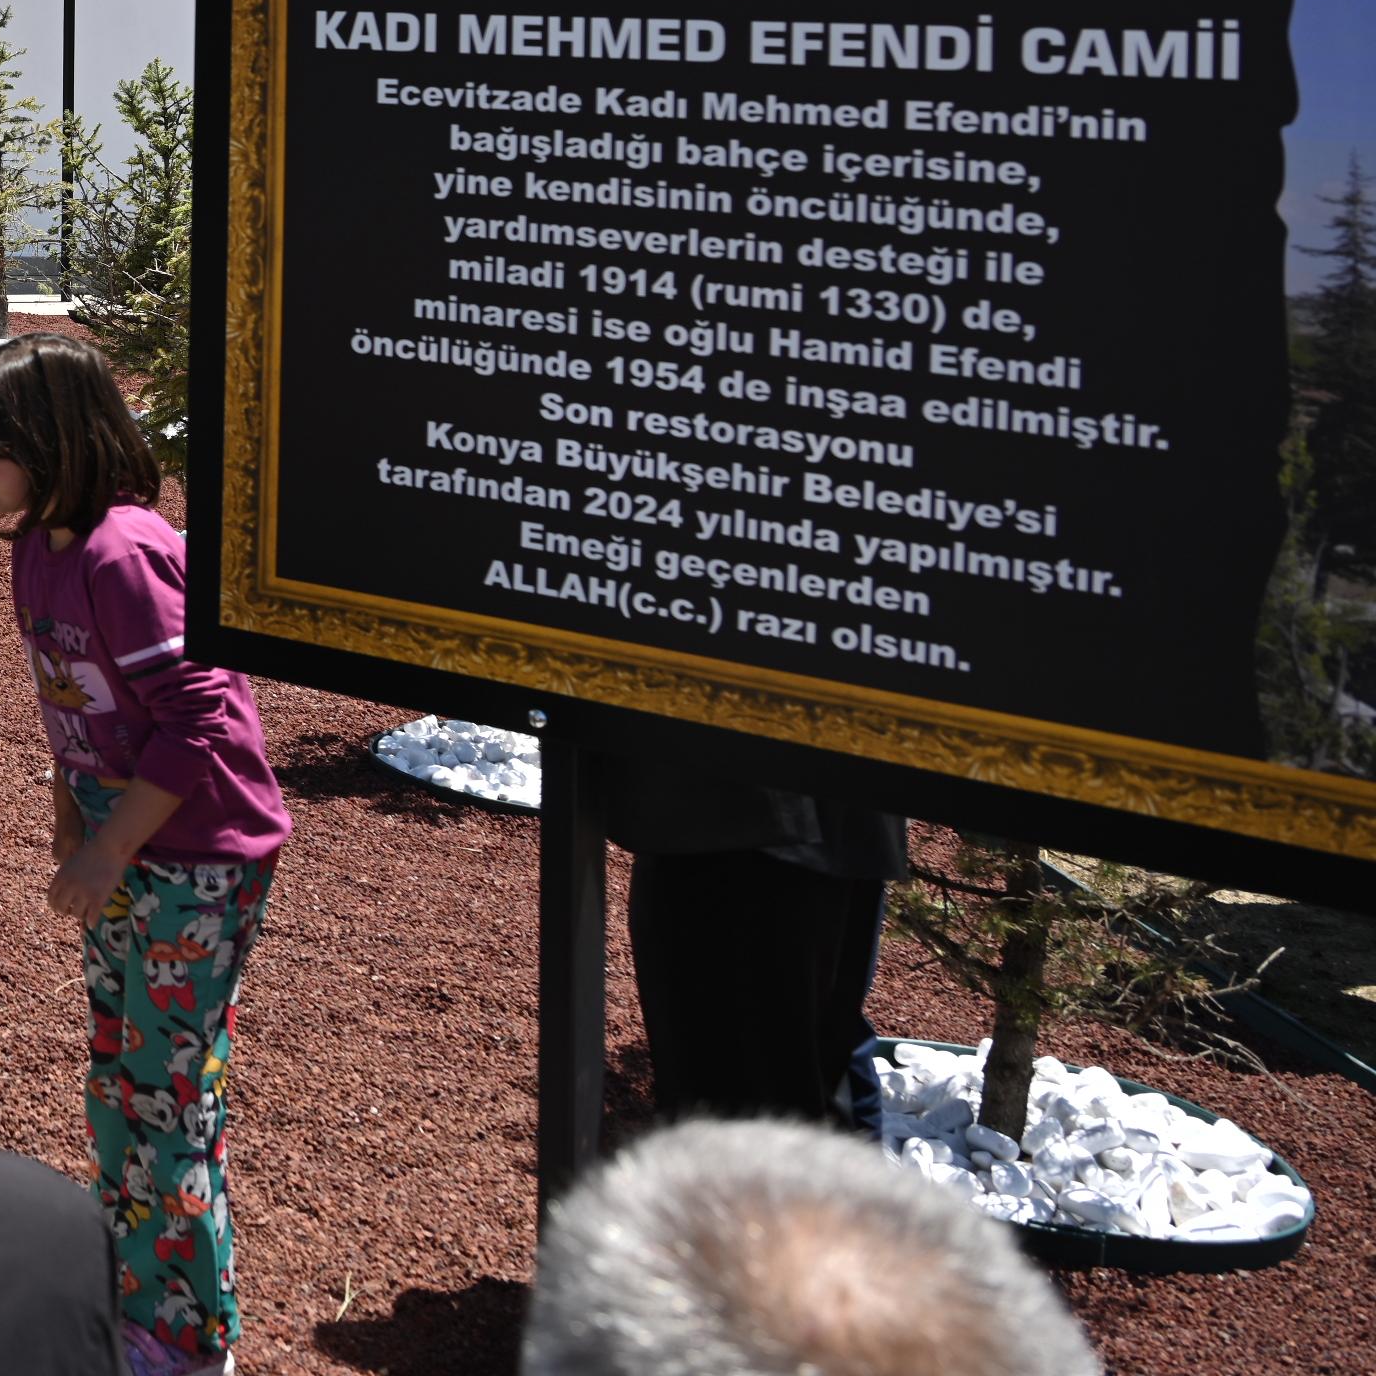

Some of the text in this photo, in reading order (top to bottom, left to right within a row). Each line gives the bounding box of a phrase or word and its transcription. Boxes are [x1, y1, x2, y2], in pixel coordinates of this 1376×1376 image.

[316, 11, 1239, 79] KADI MEHMED EFENDİ CAMİİ
[377, 78, 581, 113] Ecevitzade
[596, 88, 687, 118] Kadı
[703, 92, 887, 128] Mehmed
[451, 124, 1040, 192] bağışladığı bahçe içerisine,
[434, 167, 1058, 243] yine kendisinin öncülüğünde,
[444, 215, 1043, 285] yardımseverlerin desteği ile
[450, 256, 1035, 341] miladi 1914 (rumi 1330) de,
[415, 295, 1080, 388] minaresi ise oğlu Hamid Efendi
[351, 328, 1168, 449] öncülüğünde 1954 de inşaa edilmiştir.
[427, 421, 542, 465] Konya
[557, 439, 790, 497] Büyükşehir
[540, 393, 913, 467] Son restorasyonu
[377, 458, 1121, 596] tarafından 2024 yılında yapılmıştır.
[521, 521, 929, 615] Emeği geçenlerden
[484, 560, 969, 671] ALLAH(c.c.) razı olsun.
